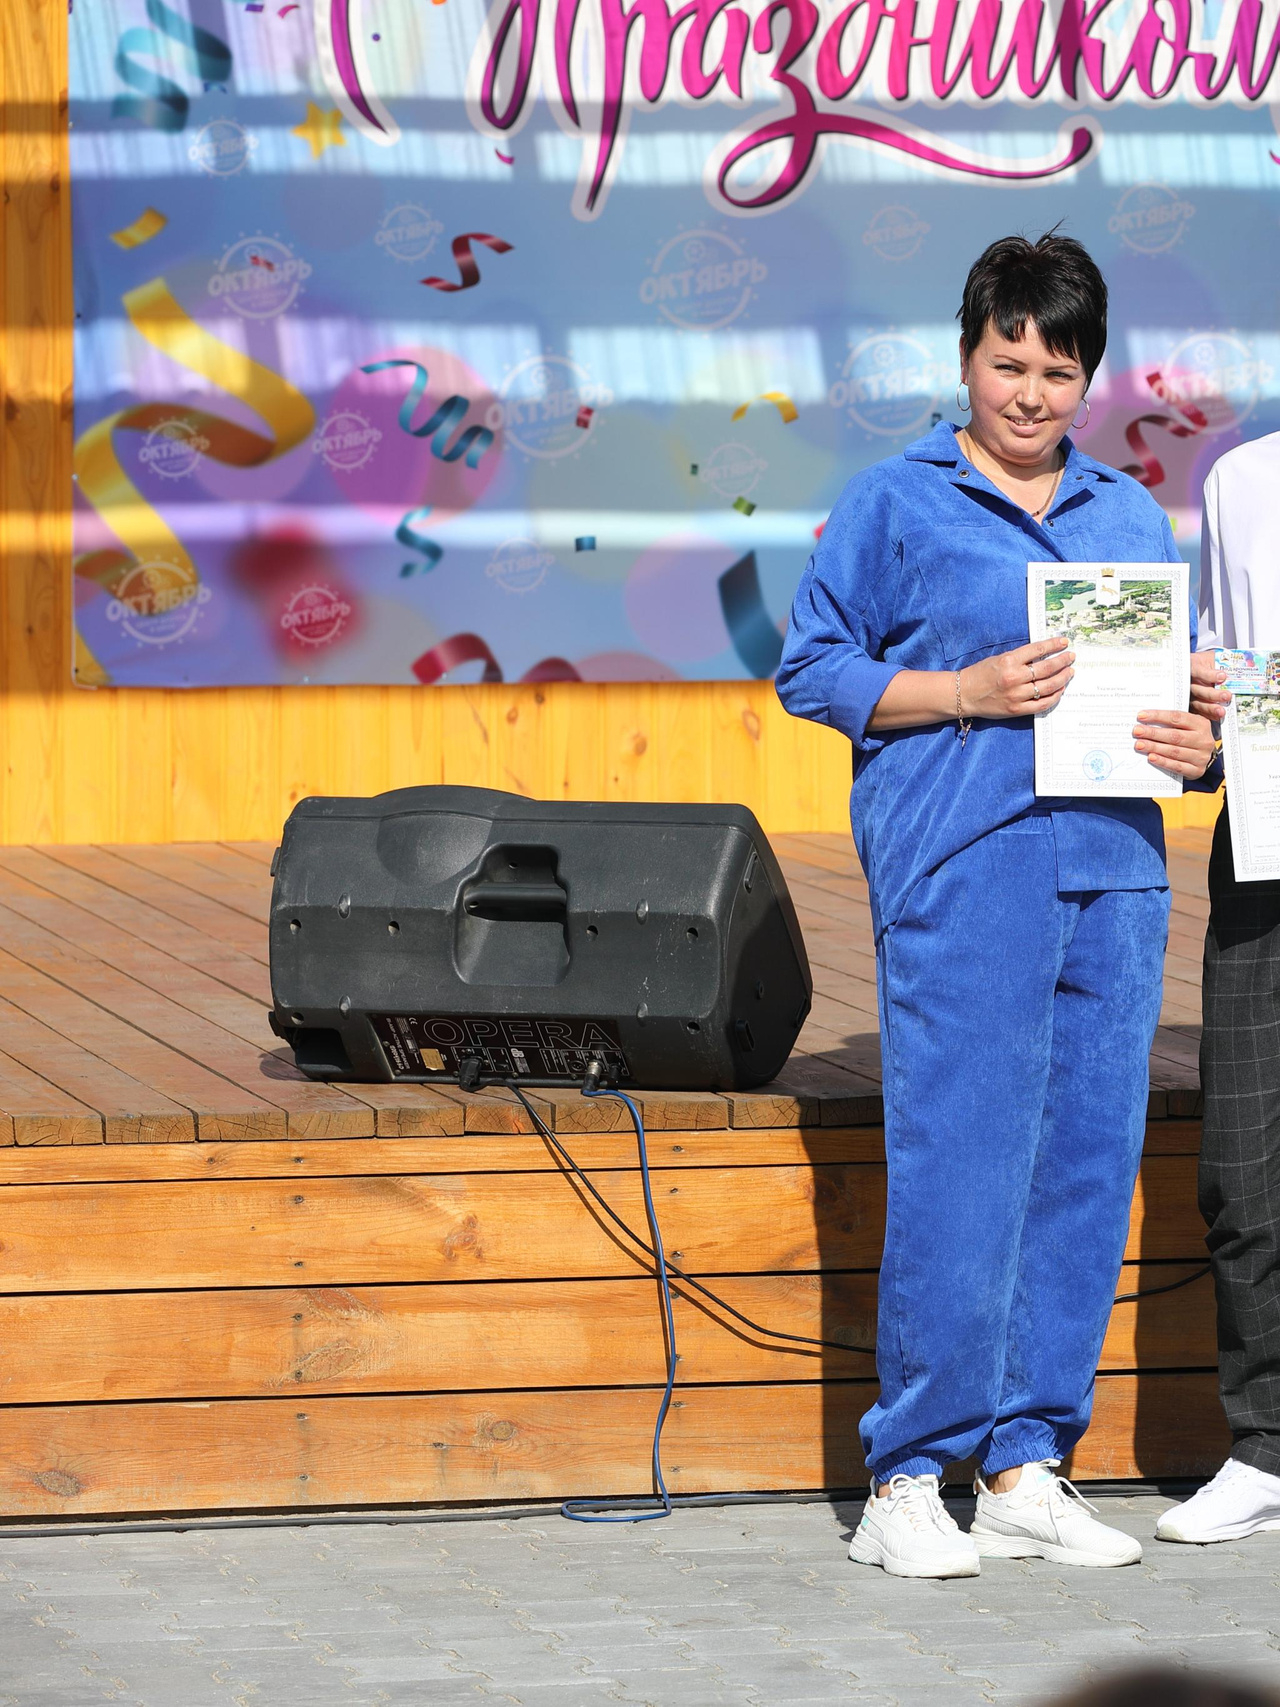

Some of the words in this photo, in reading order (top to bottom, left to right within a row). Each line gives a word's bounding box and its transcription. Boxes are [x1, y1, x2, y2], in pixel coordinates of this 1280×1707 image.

[1108, 201, 1196, 234] ОКТЯБРЬ
[208, 258, 312, 296] ОКТЯБРЬ
[640, 257, 769, 304] ОКТЯБРЬ
[829, 362, 957, 408] ОКТЯБРЬ
[485, 380, 615, 427] ОКТЯБРЬ
[139, 435, 211, 463] ОКТЯБРЬ
[312, 427, 383, 454] ОКТЯБРЬ
[106, 582, 212, 622] ОКТЯБРЬ
[281, 599, 351, 629] ОКТЯБРЬ
[423, 1018, 622, 1050] OPERA
